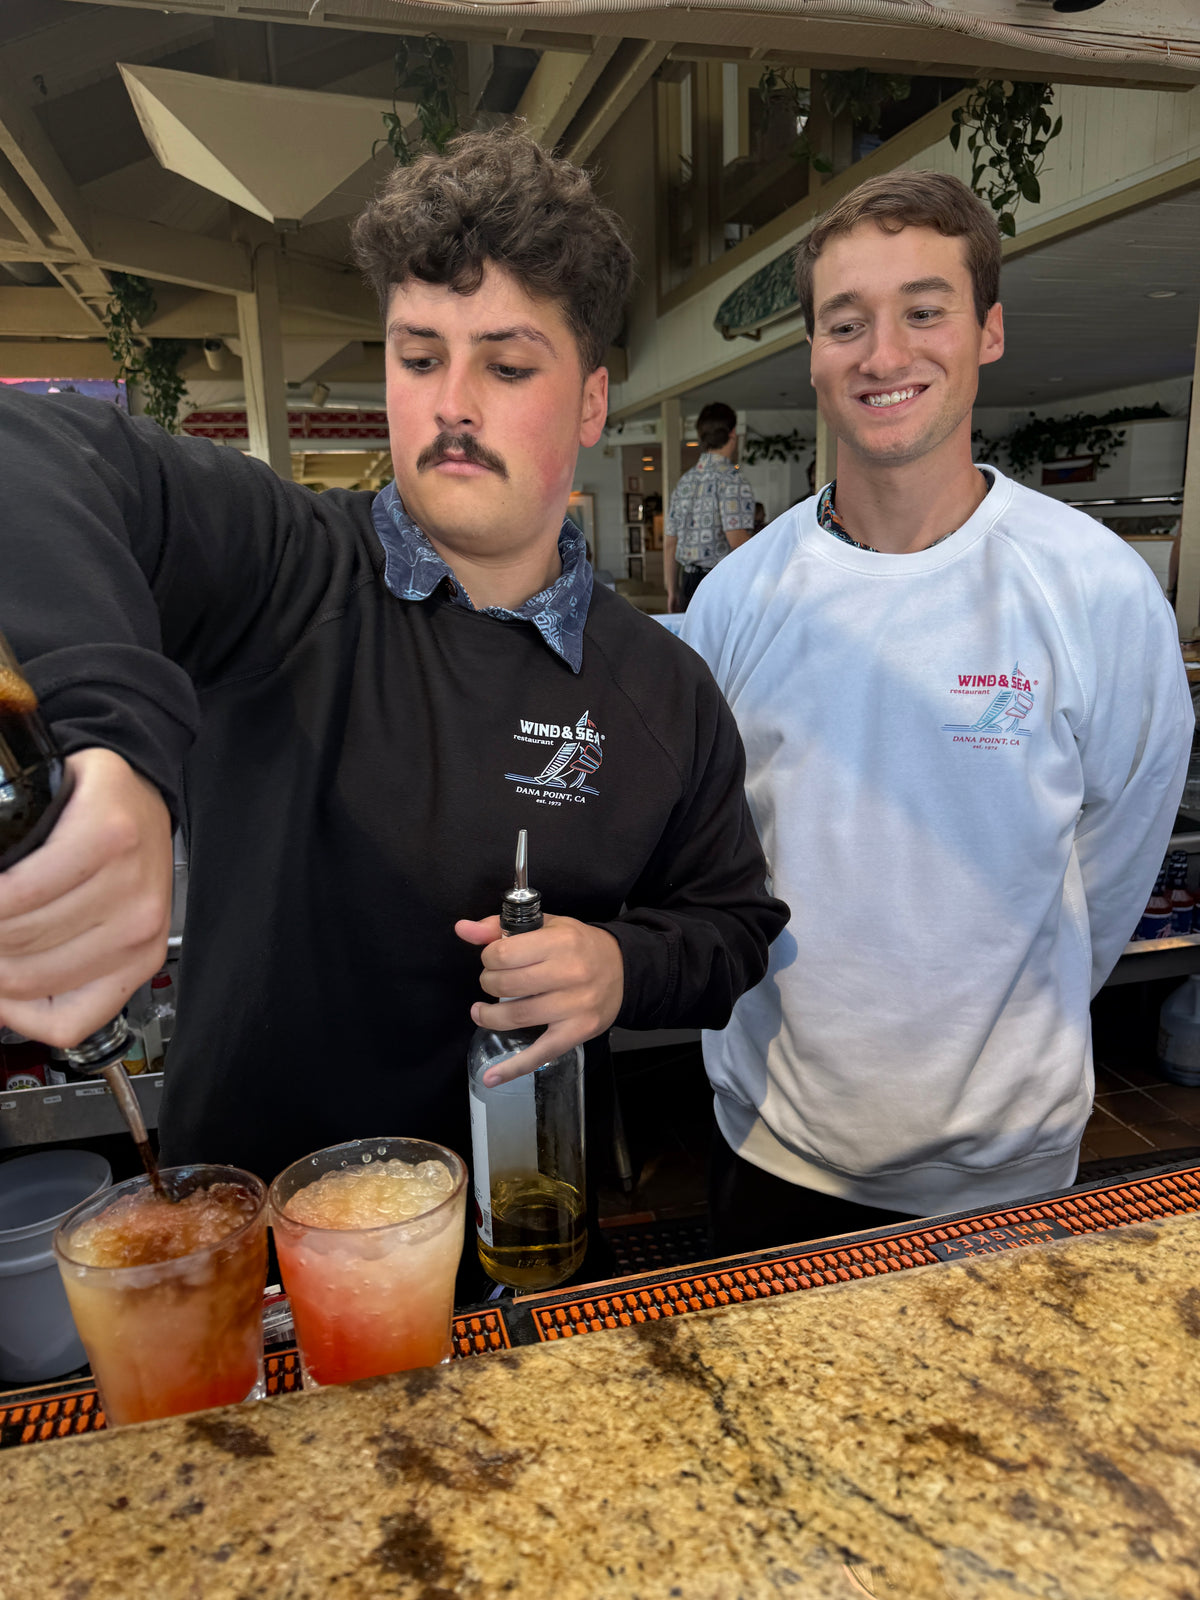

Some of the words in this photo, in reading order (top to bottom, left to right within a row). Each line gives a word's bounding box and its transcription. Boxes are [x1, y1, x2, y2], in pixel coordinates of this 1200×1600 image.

[958, 674, 997, 687] WIND
[998, 674, 1009, 688] &
[1011, 676, 1032, 692] SEA
[513, 734, 554, 746] restaurant
[520, 719, 560, 738] WIND
[561, 726, 573, 740] &
[575, 727, 600, 745] SEA
[979, 737, 1008, 746] POINT,
[515, 786, 540, 797] DANA
[543, 790, 573, 802] POINT,
[574, 795, 586, 804] CA
[943, 1221, 1054, 1255] WHISKEY
